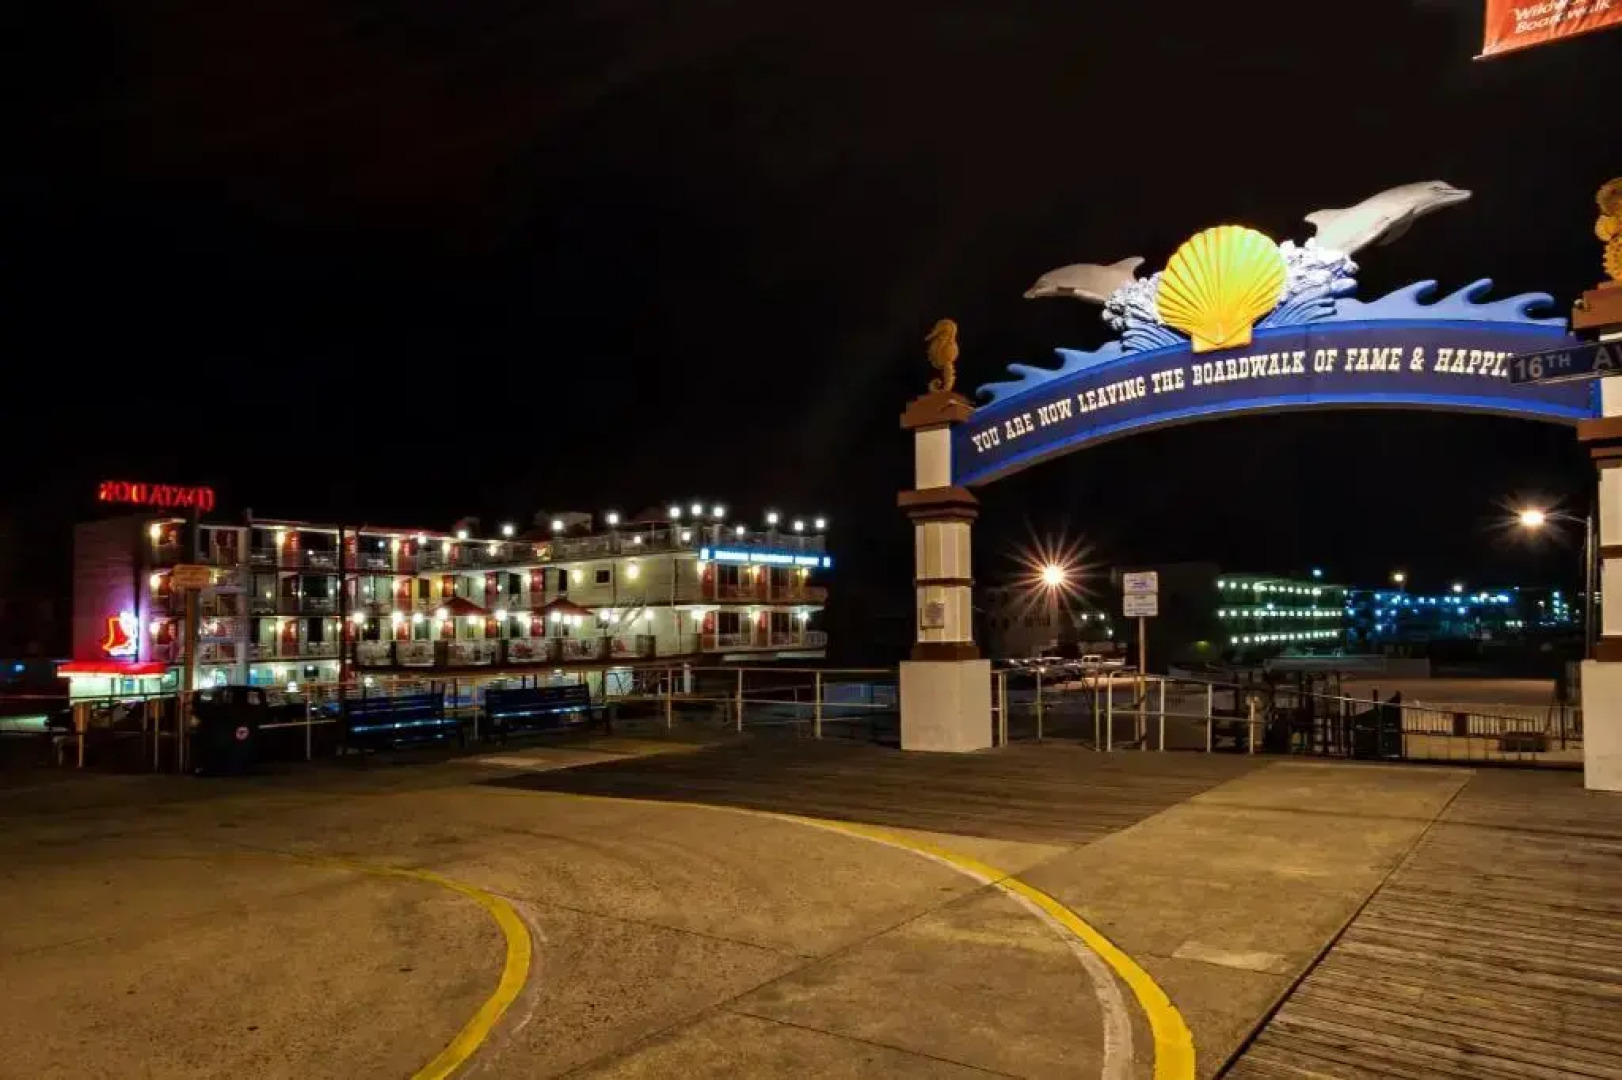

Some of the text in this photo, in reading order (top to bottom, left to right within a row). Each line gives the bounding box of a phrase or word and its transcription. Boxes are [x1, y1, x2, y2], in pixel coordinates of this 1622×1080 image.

[971, 346, 1513, 453] YOU ARE NOW LEAVING THE BOARDWALK OF FAME & HAPPI
[1514, 352, 1571, 381] 16TH
